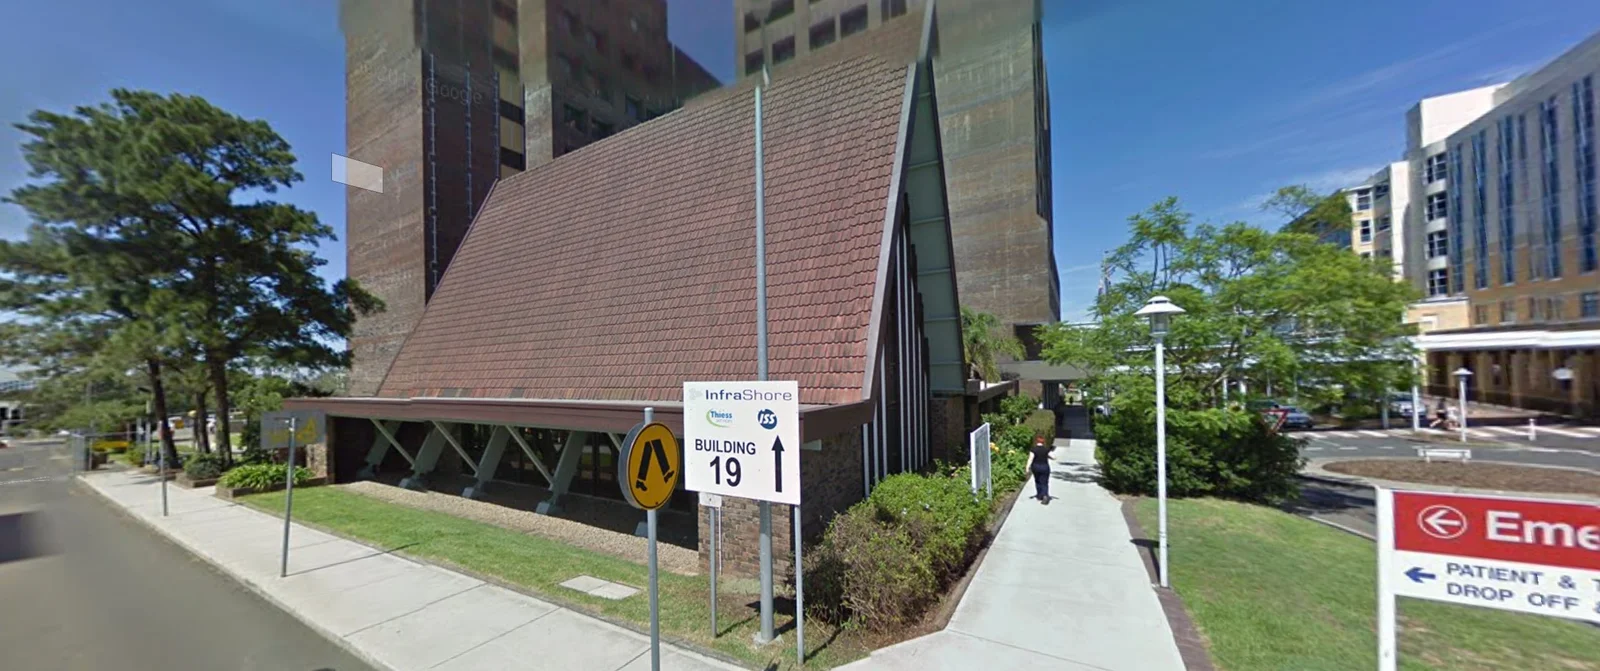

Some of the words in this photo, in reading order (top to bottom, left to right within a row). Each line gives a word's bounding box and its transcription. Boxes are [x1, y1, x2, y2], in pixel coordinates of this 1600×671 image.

[705, 389, 792, 401] InfraShore
[759, 413, 775, 425] ISS
[695, 439, 756, 455] BUILDING
[709, 455, 742, 487] 19
[1446, 562, 1544, 586] PATIENT
[1557, 575, 1576, 590] &
[1446, 582, 1513, 602] DROP
[1527, 593, 1581, 611] OFF
